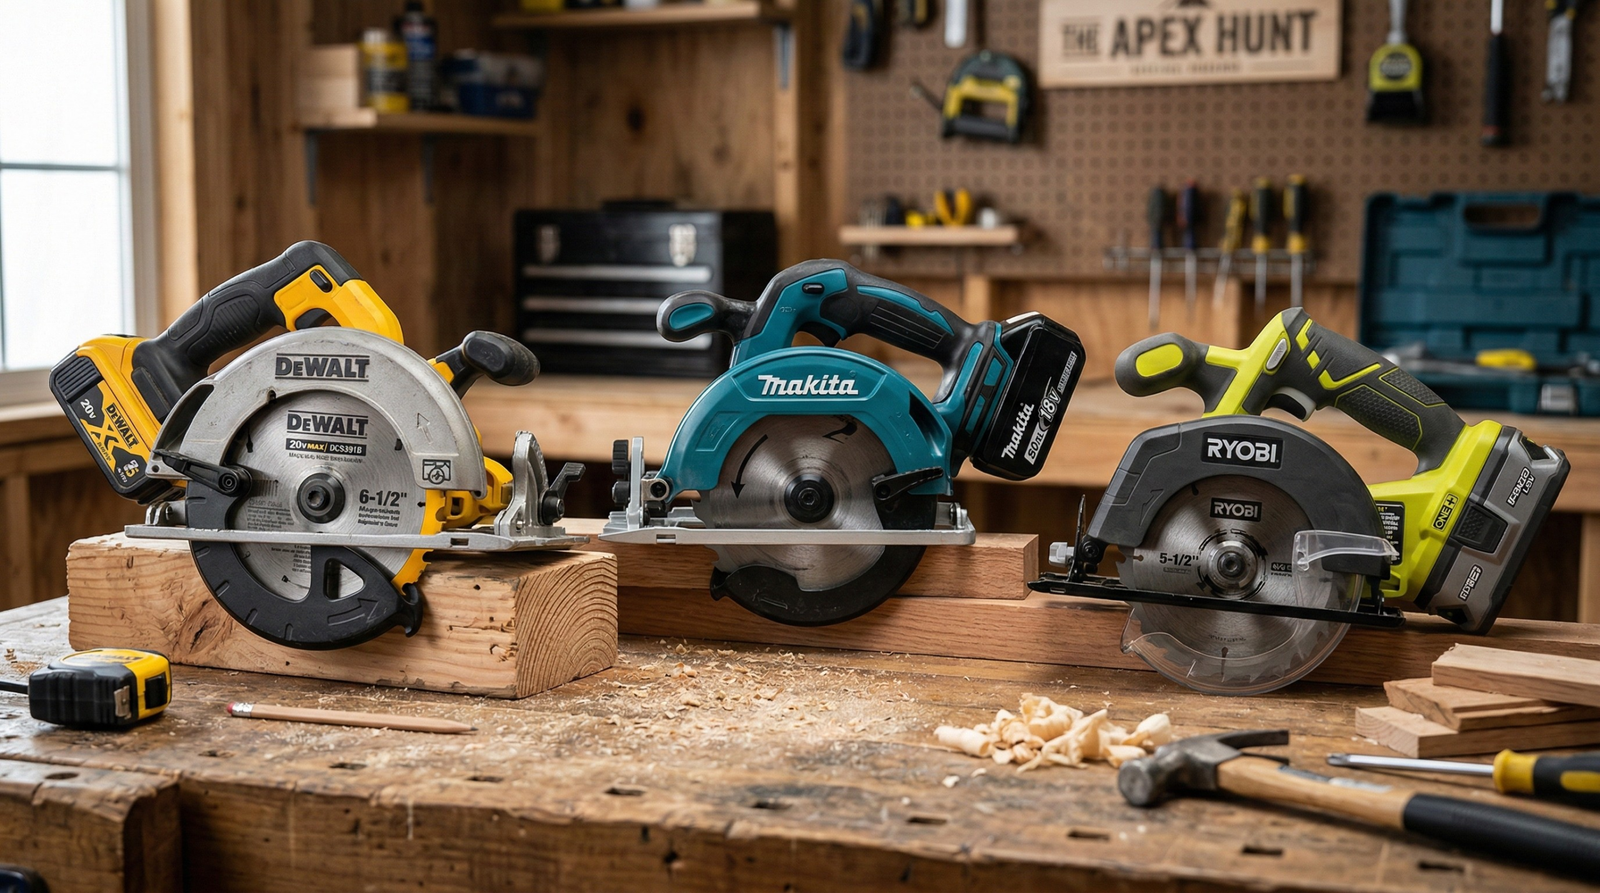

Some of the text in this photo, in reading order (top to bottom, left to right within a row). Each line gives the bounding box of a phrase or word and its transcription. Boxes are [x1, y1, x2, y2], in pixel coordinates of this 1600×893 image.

[1111, 16, 1203, 57] APEX
[1217, 10, 1318, 54] HUNT
[1207, 438, 1279, 463] RYOBI
[359, 489, 408, 507] 6-1/2"
[1214, 502, 1258, 518] RYOBI
[1159, 553, 1199, 567] 5-1/2"
